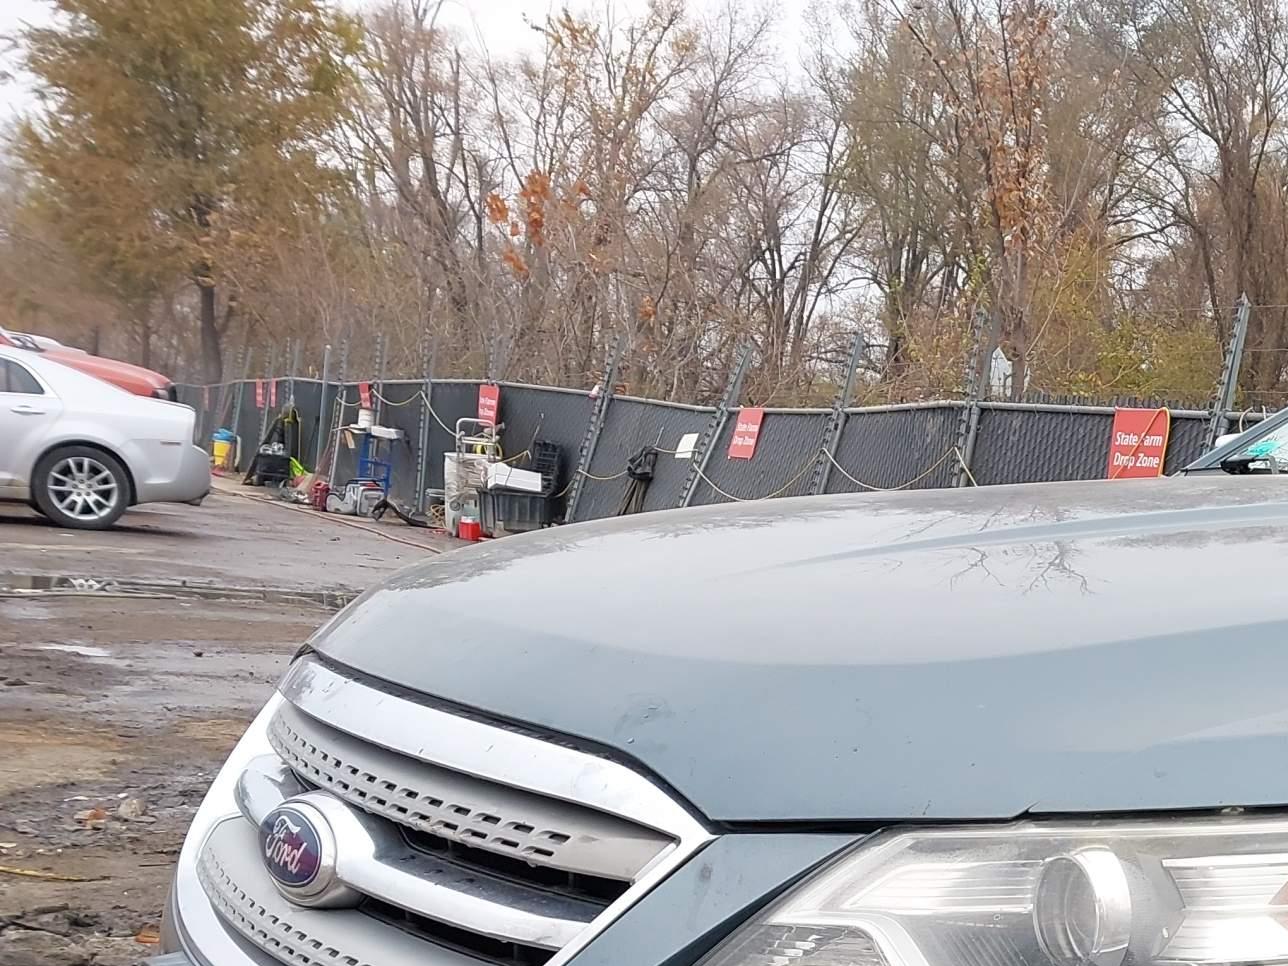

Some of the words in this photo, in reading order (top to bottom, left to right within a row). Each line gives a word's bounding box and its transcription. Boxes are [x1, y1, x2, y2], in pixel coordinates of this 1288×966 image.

[1114, 431, 1138, 446] State
[1113, 451, 1135, 470] Drop
[1135, 452, 1160, 468] Zone
[265, 815, 308, 875] Ford
